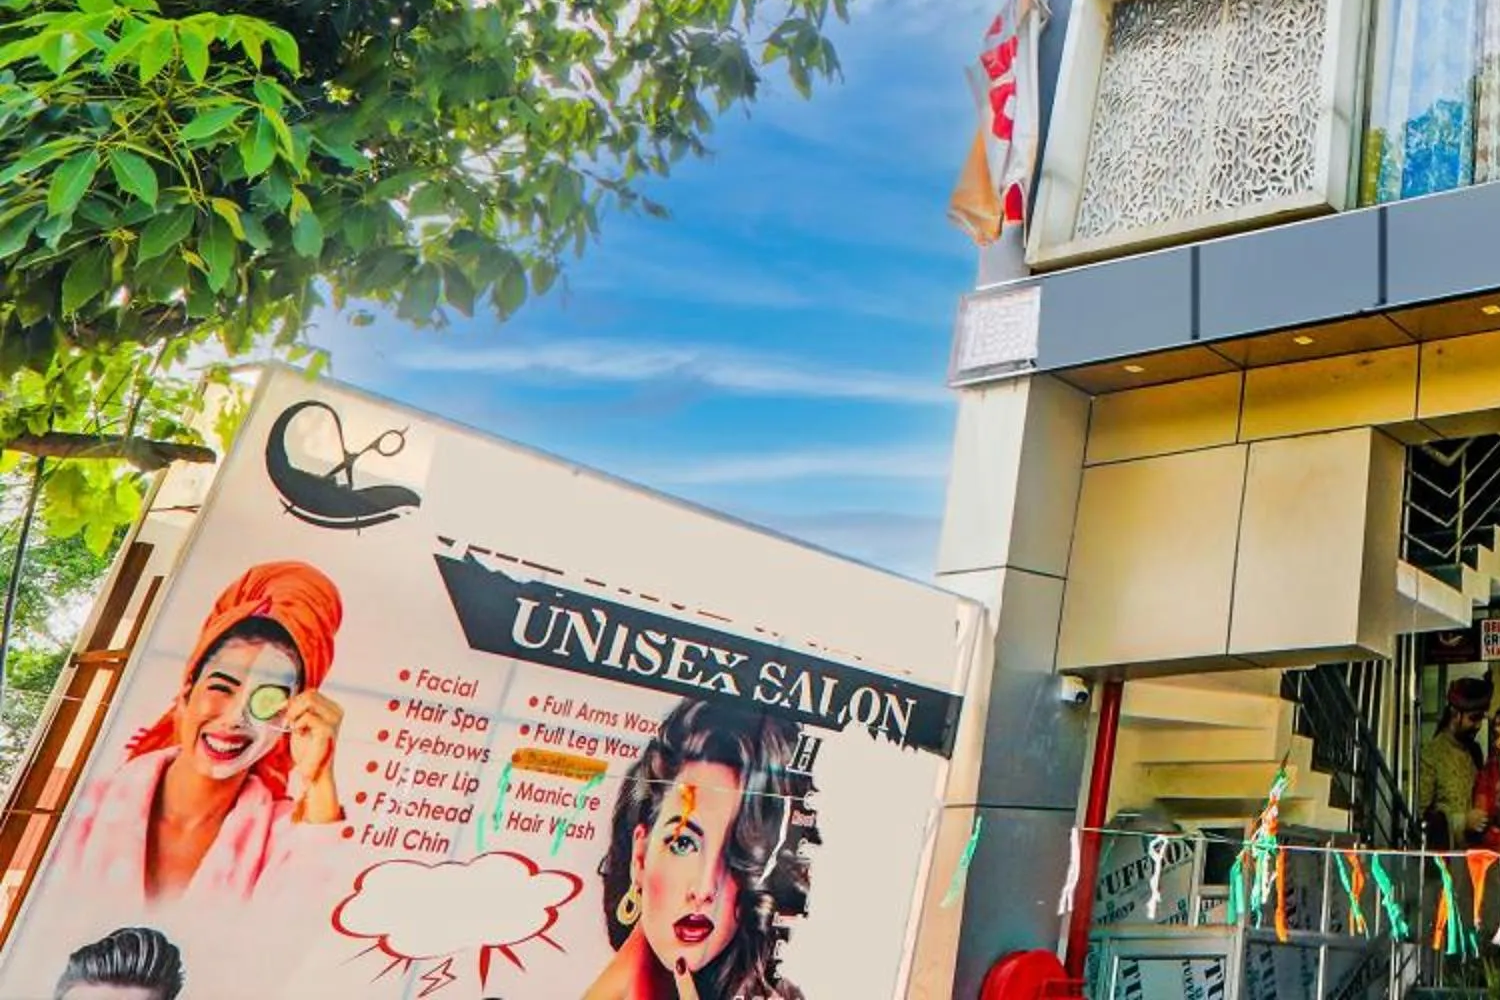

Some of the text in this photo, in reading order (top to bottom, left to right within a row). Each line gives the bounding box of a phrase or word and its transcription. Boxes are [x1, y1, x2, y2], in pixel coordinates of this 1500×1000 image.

[511, 597, 917, 736] UNISEX SALON
[416, 669, 479, 699] Facial
[405, 699, 489, 733] Hair Spa
[542, 695, 658, 736] Full Arms Wax
[394, 729, 490, 763] Eyebrows
[534, 722, 641, 759] Full Leg Wax
[451, 770, 480, 795] Lip
[361, 823, 450, 854] Full Chin
[506, 811, 545, 835] Hair
